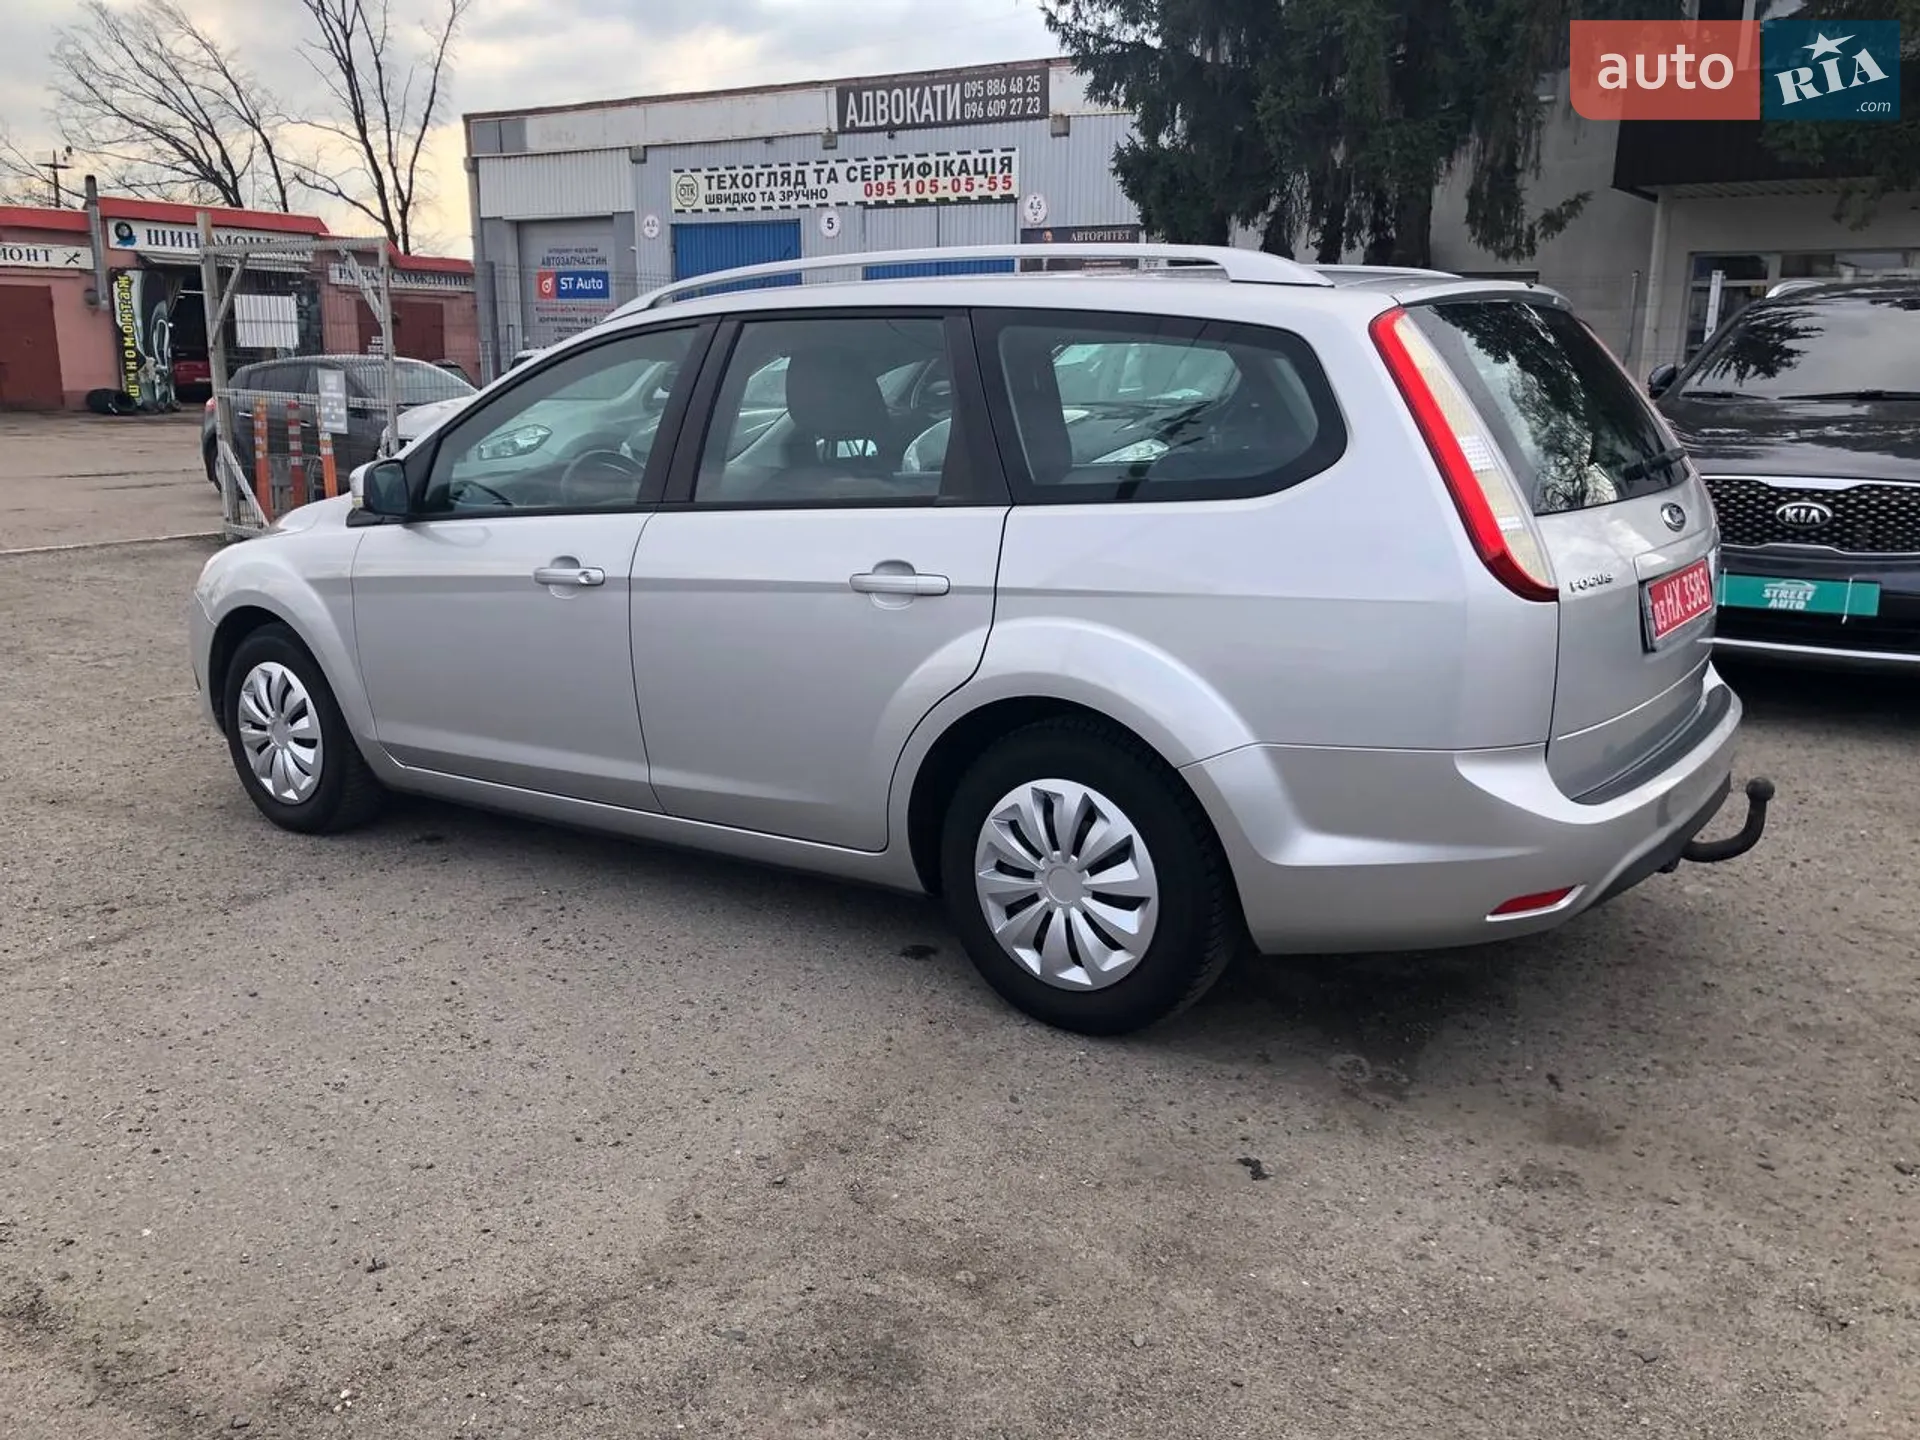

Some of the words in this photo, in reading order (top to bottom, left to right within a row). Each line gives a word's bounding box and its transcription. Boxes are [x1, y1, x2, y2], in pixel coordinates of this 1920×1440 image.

[964, 80, 984, 98] 095
[987, 78, 1006, 96] 886
[1009, 76, 1023, 94] 48
[1026, 75, 1041, 92] 25
[845, 83, 961, 128] АДВОКАТИ
[964, 101, 984, 119] 096
[987, 99, 1006, 117] 609
[1009, 97, 1023, 115] 27
[1026, 97, 1041, 114] 23
[704, 169, 807, 191] ТЕХОГЛЯД
[813, 167, 839, 185] ТА
[846, 156, 1013, 183] СЕРТИФІКАЦІЯ
[864, 181, 896, 198] 095
[903, 175, 1013, 195] 105-05-55
[704, 191, 756, 205] ШВИДКО
[760, 191, 776, 202] ТА
[779, 188, 828, 202] ЗРУЧНО
[826, 217, 834, 230] 5
[560, 277, 574, 290] ST
[576, 277, 603, 290] Auto
[1784, 507, 1821, 524] KIA
[1569, 573, 1613, 593] FOCUS
[1761, 588, 1816, 602] STREET
[1769, 599, 1807, 610] AUTO
